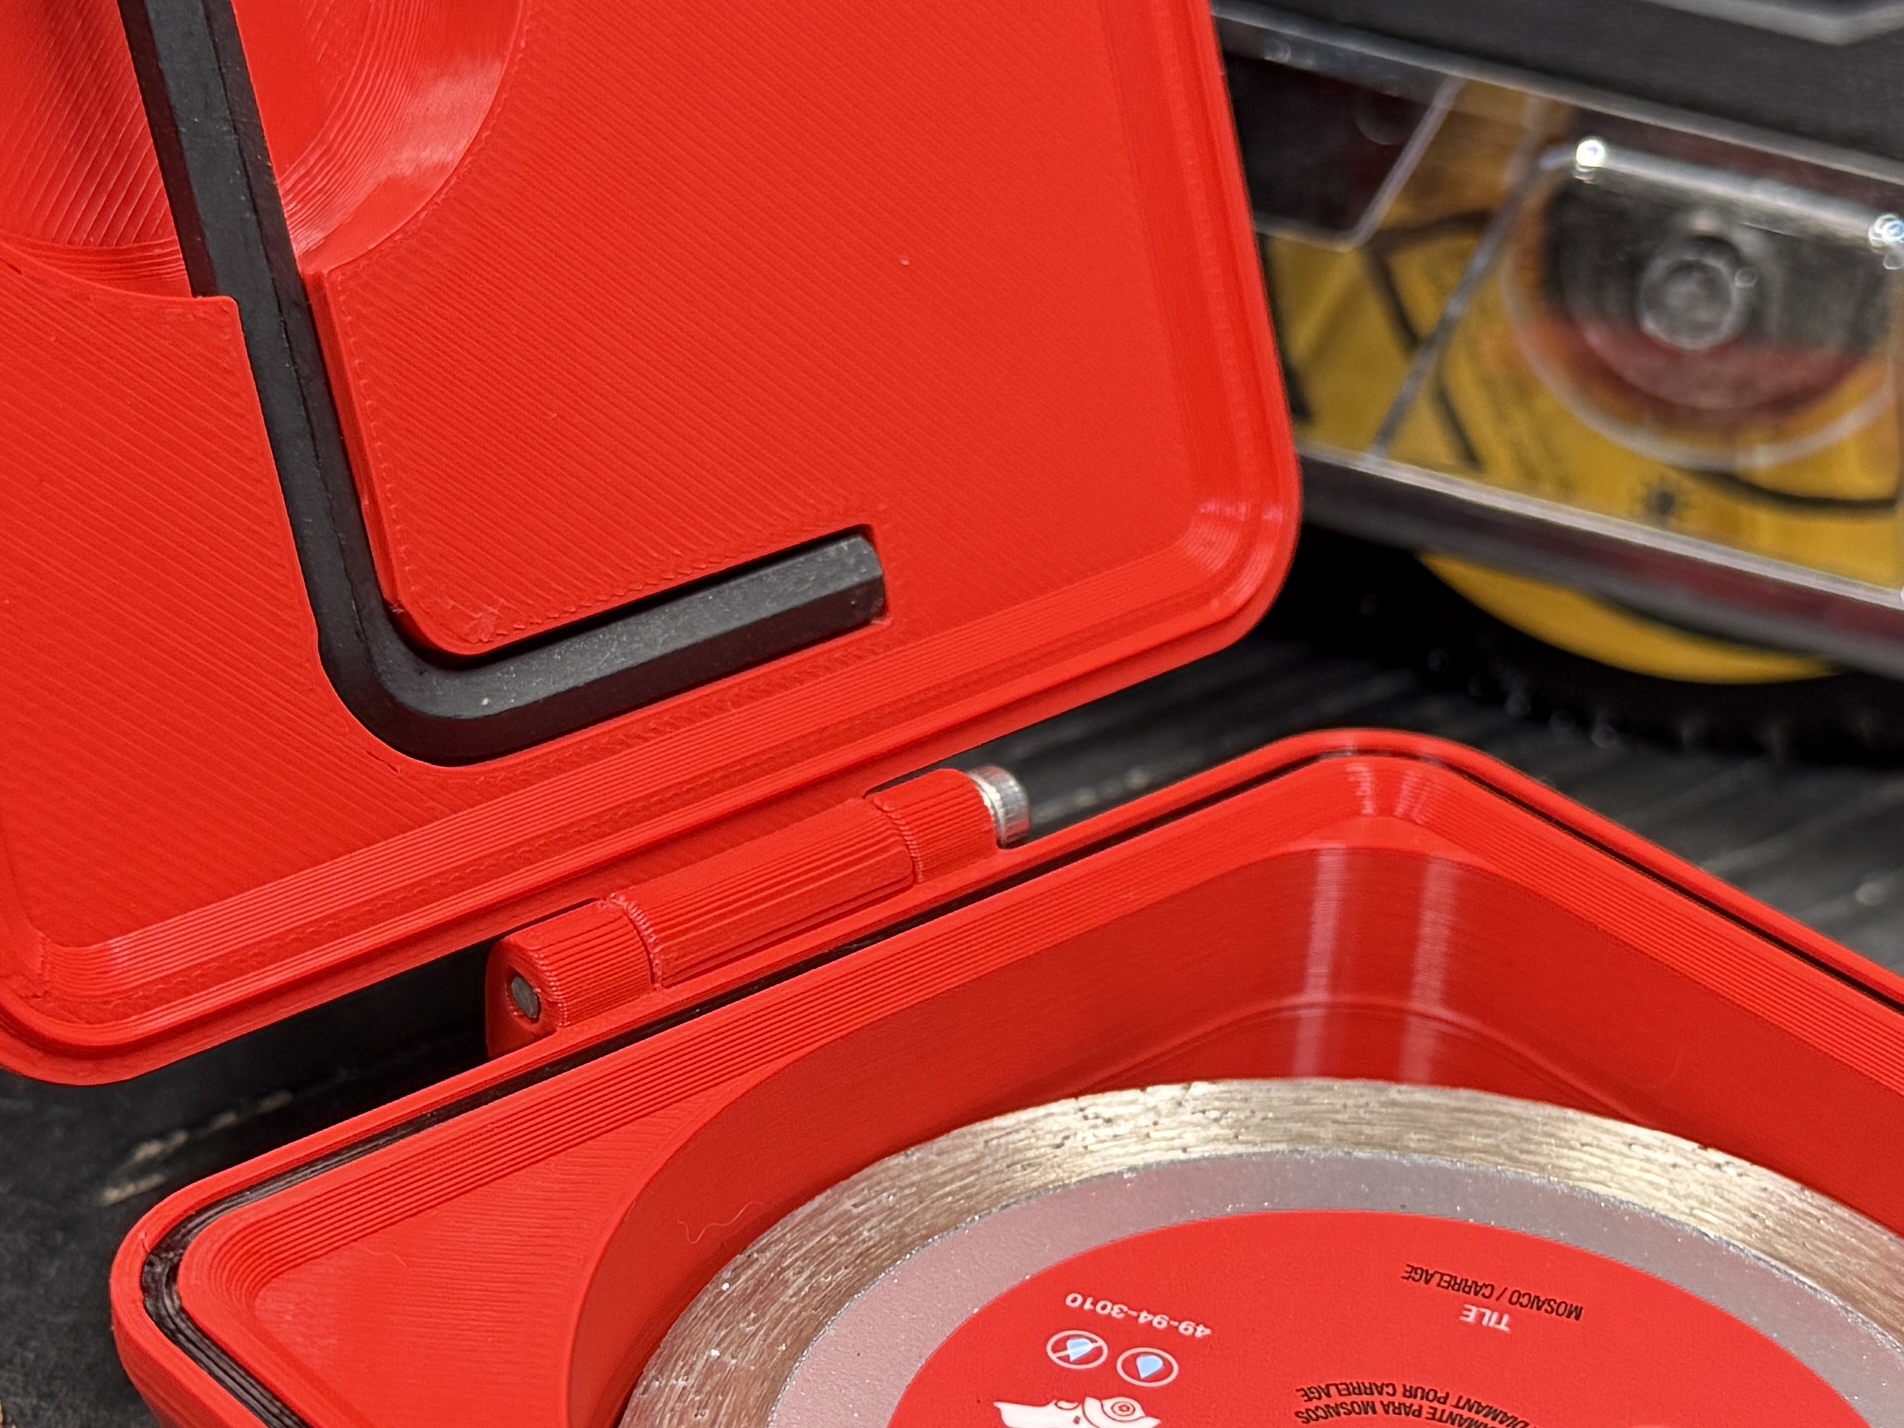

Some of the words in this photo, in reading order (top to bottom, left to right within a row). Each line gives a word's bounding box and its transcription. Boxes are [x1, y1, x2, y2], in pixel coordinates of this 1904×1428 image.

[1401, 1264, 1496, 1300] CARRELAGE
[1496, 1288, 1508, 1302] /
[1508, 1289, 1584, 1321] MOSAICO
[1065, 1292, 1212, 1339] 49-94-3010
[1459, 1303, 1512, 1334] TILE
[1296, 1382, 1397, 1403] CARRELAGE
[1402, 1384, 1450, 1406] POUR
[1294, 1400, 1377, 1425] MOSAICOS
[1380, 1400, 1424, 1418] PARA
